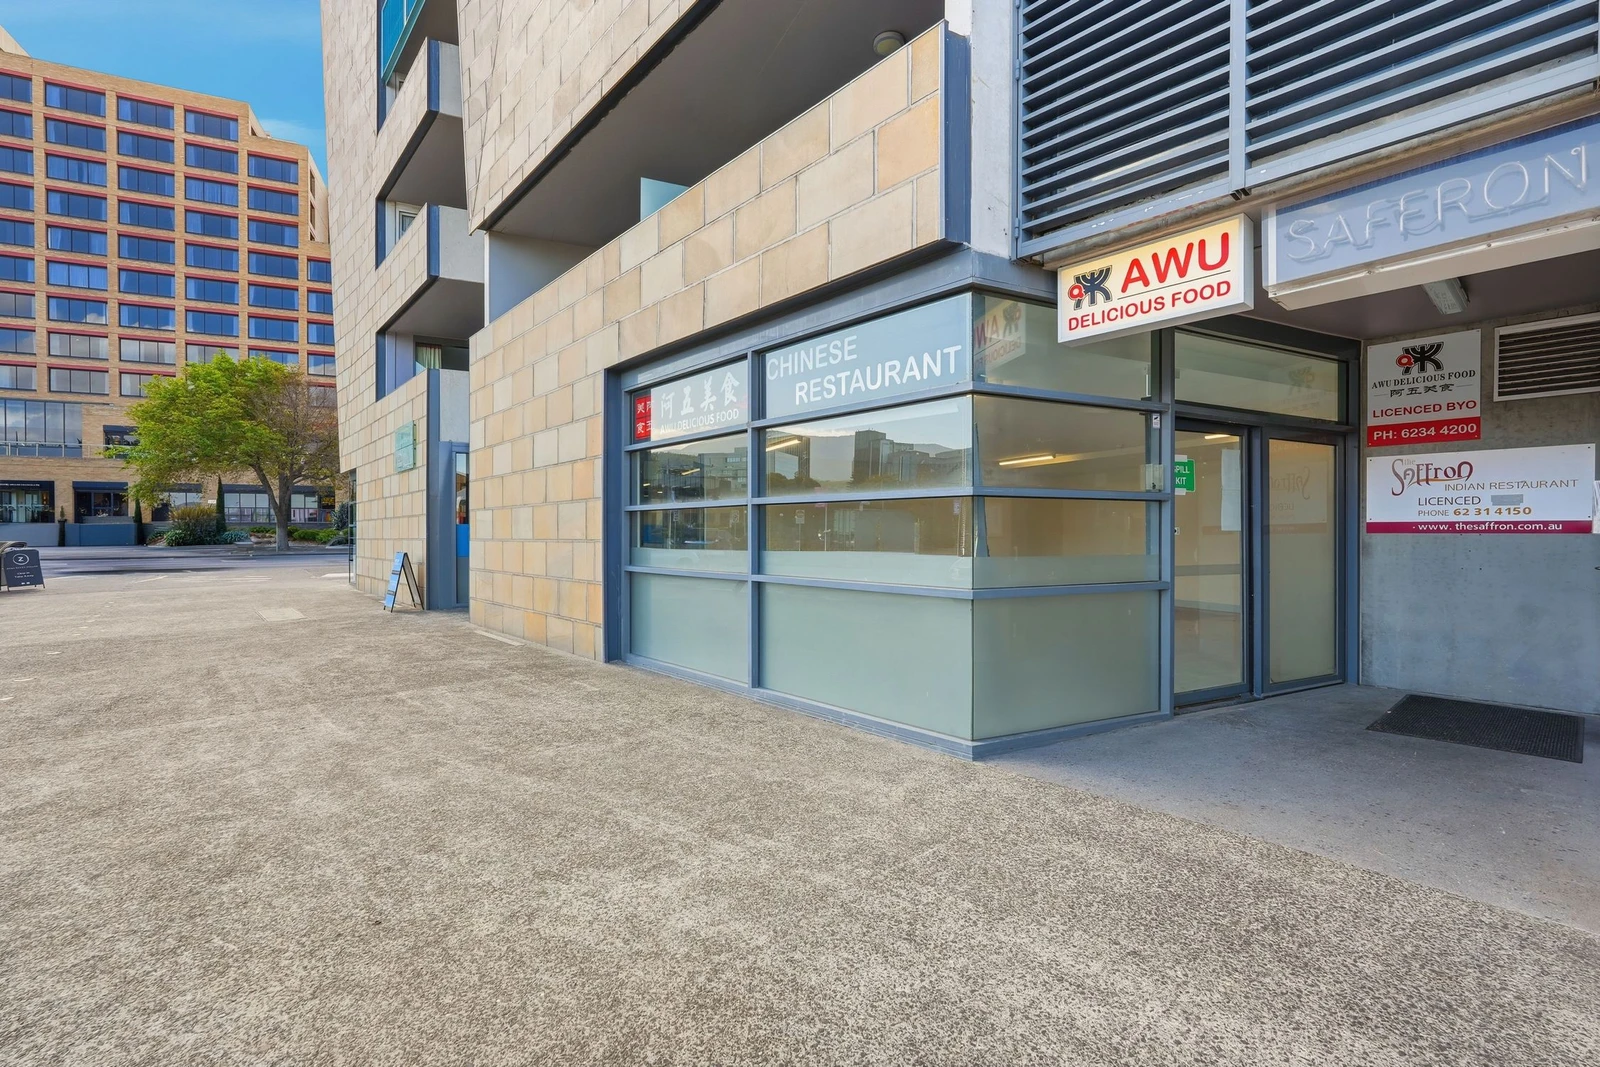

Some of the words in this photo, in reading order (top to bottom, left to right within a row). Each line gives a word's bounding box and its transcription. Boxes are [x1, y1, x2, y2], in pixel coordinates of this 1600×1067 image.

[1286, 143, 1588, 260] SAFFRON
[1120, 232, 1230, 294] AWU
[1068, 296, 1166, 332] DELICIOUS
[1171, 280, 1232, 308] FOOD
[766, 335, 858, 381] CHINESE
[795, 345, 962, 405] RESTAURANT
[1371, 379, 1392, 389] AWU
[1393, 373, 1446, 387] DELICIOUS
[1448, 369, 1476, 380] FOOD
[660, 371, 740, 419] 阿五美食
[1389, 383, 1455, 398] 阿五美食
[677, 413, 715, 431] DELICIOUS
[716, 408, 739, 423] FOOD
[1372, 403, 1443, 419] LICENCED
[1446, 400, 1477, 411] BYO
[1373, 430, 1397, 441] PH:
[1401, 426, 1437, 439] 6234
[1439, 423, 1477, 436] 4200
[1175, 476, 1187, 485] KIT
[1444, 482, 1485, 492] INDIAN
[1489, 479, 1579, 490] RESTAURANT
[1418, 495, 1482, 506] LICENCED
[1418, 509, 1449, 517] PHONE
